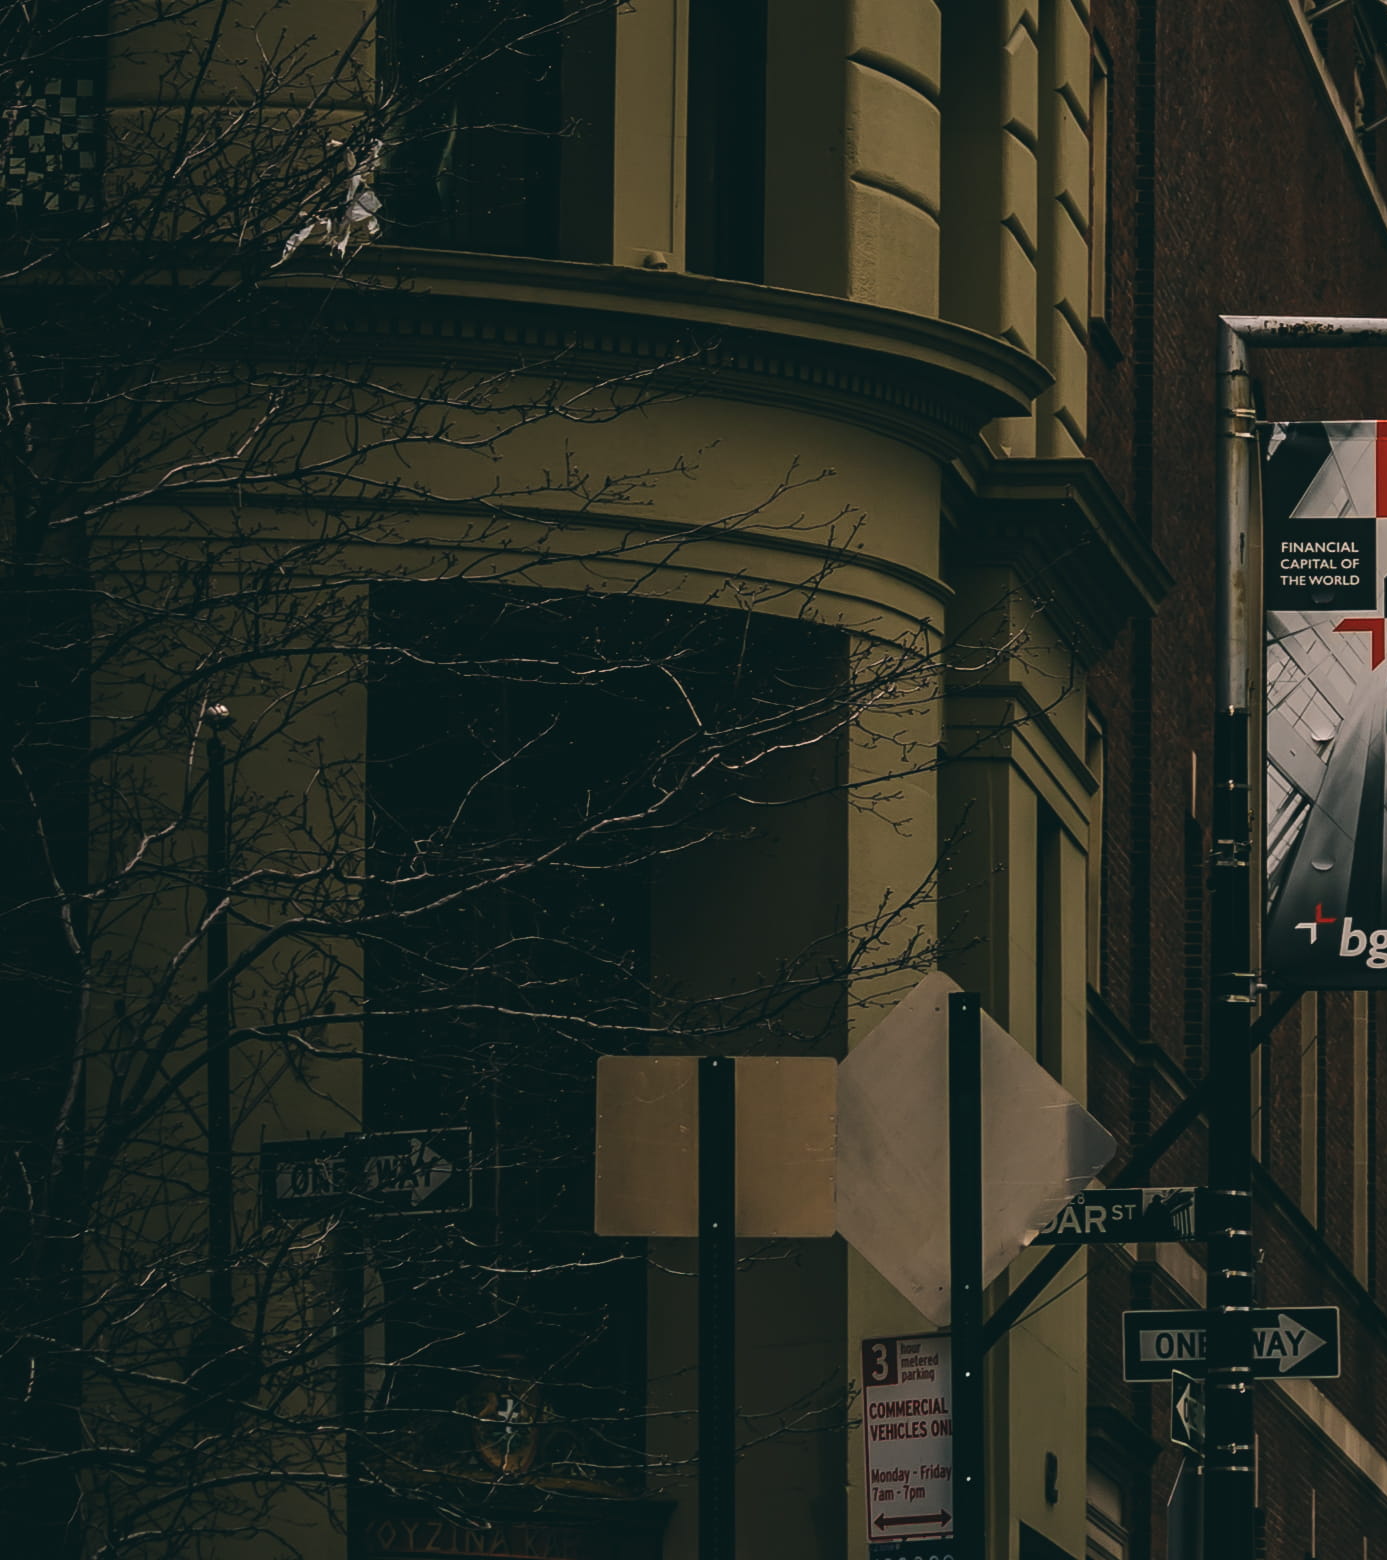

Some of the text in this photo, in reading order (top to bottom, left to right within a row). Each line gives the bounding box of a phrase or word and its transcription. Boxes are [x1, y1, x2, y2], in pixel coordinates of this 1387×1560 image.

[1280, 541, 1360, 554] FINANCIAL
[1280, 558, 1360, 570] CAPITAL OF
[1280, 575, 1360, 587] THE WORLD
[1111, 1204, 1137, 1221] ST
[900, 1343, 921, 1355] hour
[872, 1343, 889, 1381] 3
[901, 1353, 939, 1369] metered
[901, 1368, 935, 1383] parking
[869, 1398, 948, 1420] COMMERCIAL
[870, 1421, 928, 1441] VEHICLES
[871, 1468, 910, 1484] Monday
[920, 1464, 952, 1481] Friday
[873, 1487, 894, 1501] 7am
[903, 1485, 926, 1502] 7pm
